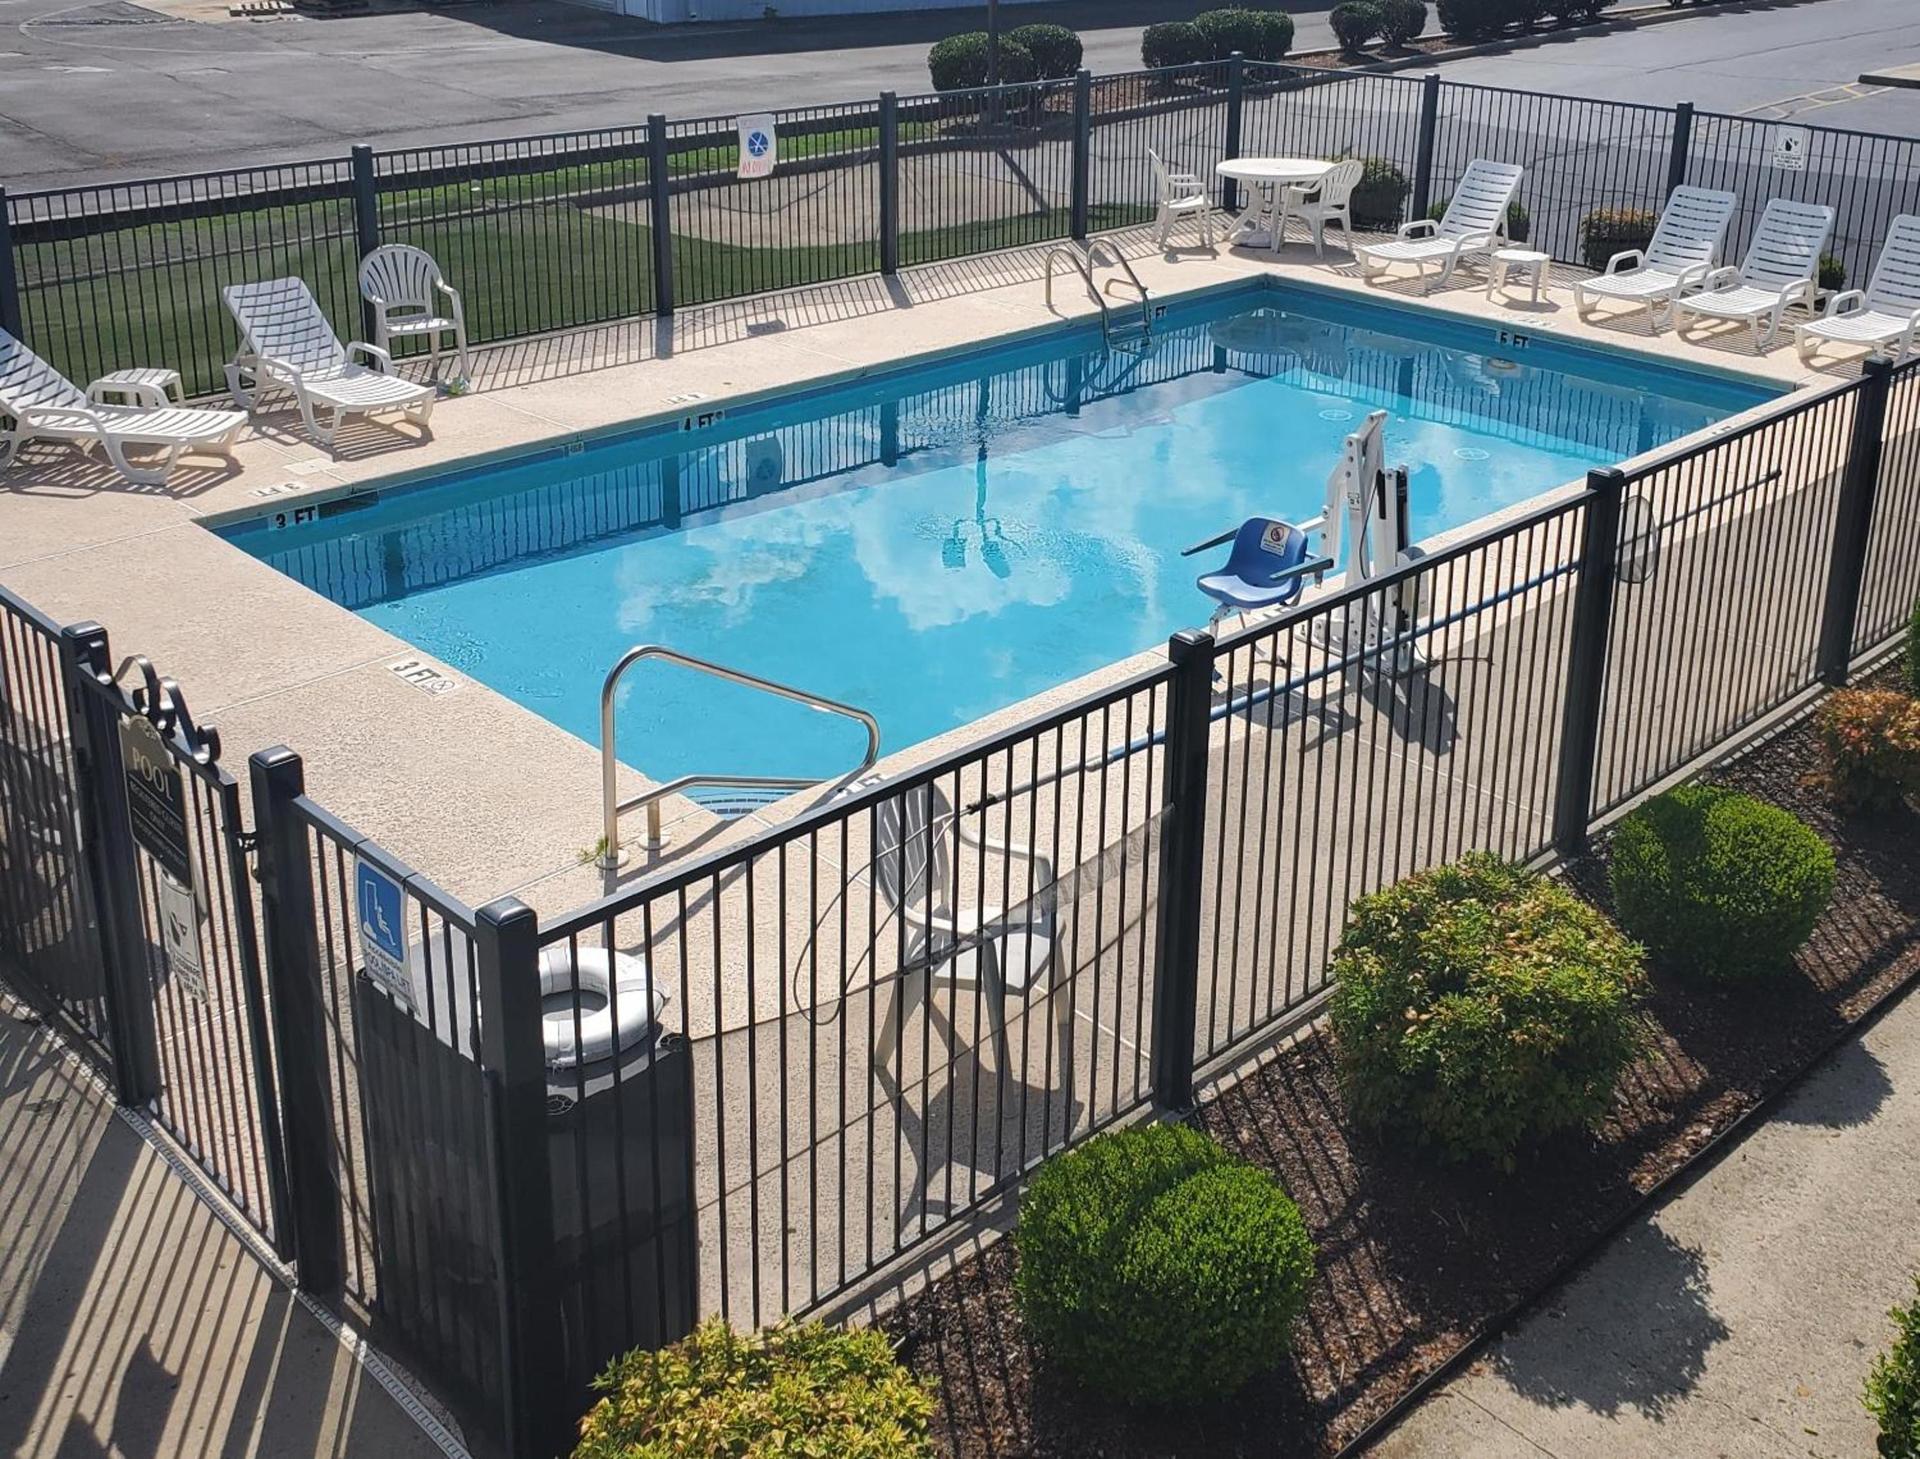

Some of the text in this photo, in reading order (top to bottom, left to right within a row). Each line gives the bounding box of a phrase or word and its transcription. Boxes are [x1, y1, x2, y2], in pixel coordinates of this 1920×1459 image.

[1513, 335, 1529, 348] FT
[698, 412, 714, 428] FT
[275, 506, 316, 529] 3 FT
[404, 668, 442, 684] FT
[131, 746, 174, 802] POOL
